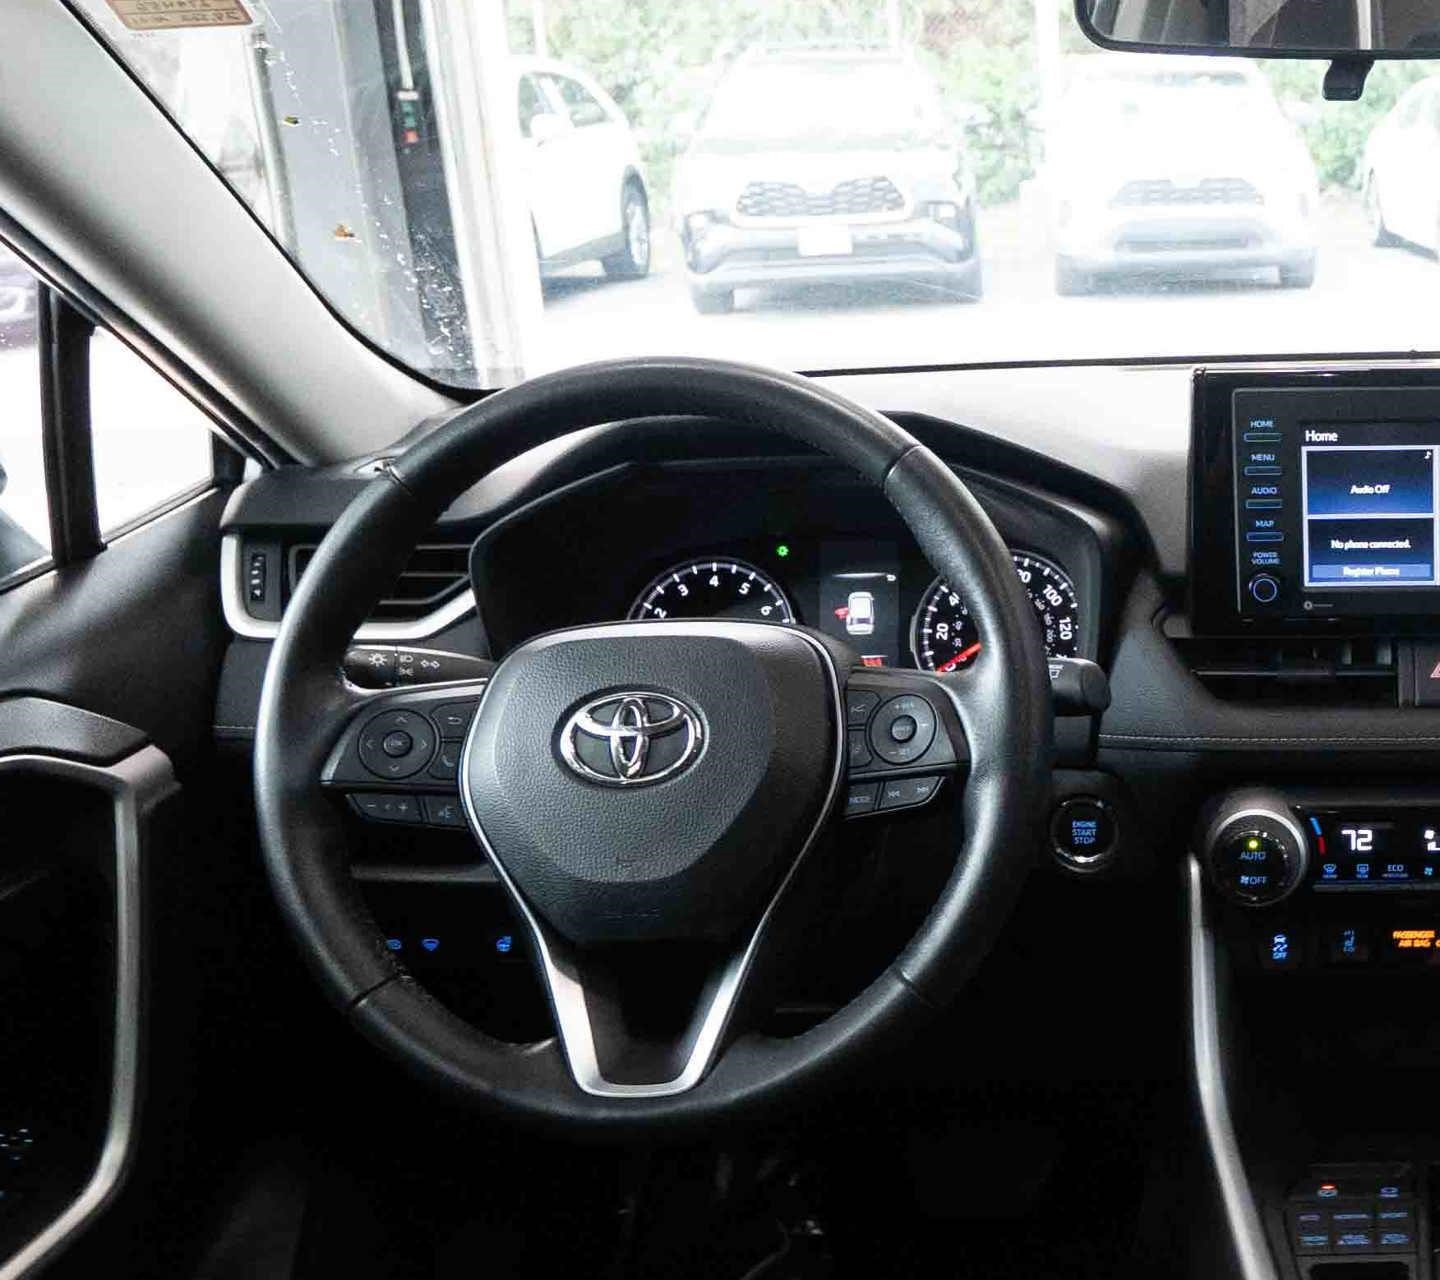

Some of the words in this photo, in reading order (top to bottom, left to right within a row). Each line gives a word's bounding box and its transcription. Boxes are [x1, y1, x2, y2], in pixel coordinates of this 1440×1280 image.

[1250, 420, 1274, 428] HOME
[1305, 430, 1339, 442] Home
[1251, 454, 1276, 462] MENU
[1251, 487, 1278, 495] AUDIO
[1350, 485, 1374, 494] Audio
[1375, 484, 1391, 494] Off
[1255, 520, 1274, 528] MAP
[1331, 539, 1344, 549] No
[1344, 539, 1369, 551] phone
[709, 575, 720, 587] 4
[677, 584, 690, 597] 3
[738, 583, 751, 595] 5
[1042, 584, 1064, 607] 100
[654, 607, 667, 619] 2
[760, 605, 772, 616] 6
[936, 622, 949, 640] 20
[1059, 616, 1073, 640] 120
[1071, 828, 1097, 837] START
[1074, 836, 1096, 844] STOP
[1341, 829, 1373, 851] 72
[1240, 852, 1267, 861] AUTO
[1387, 864, 1405, 872] ECO
[1250, 875, 1267, 885] OFF
[1272, 951, 1288, 960] OFF
